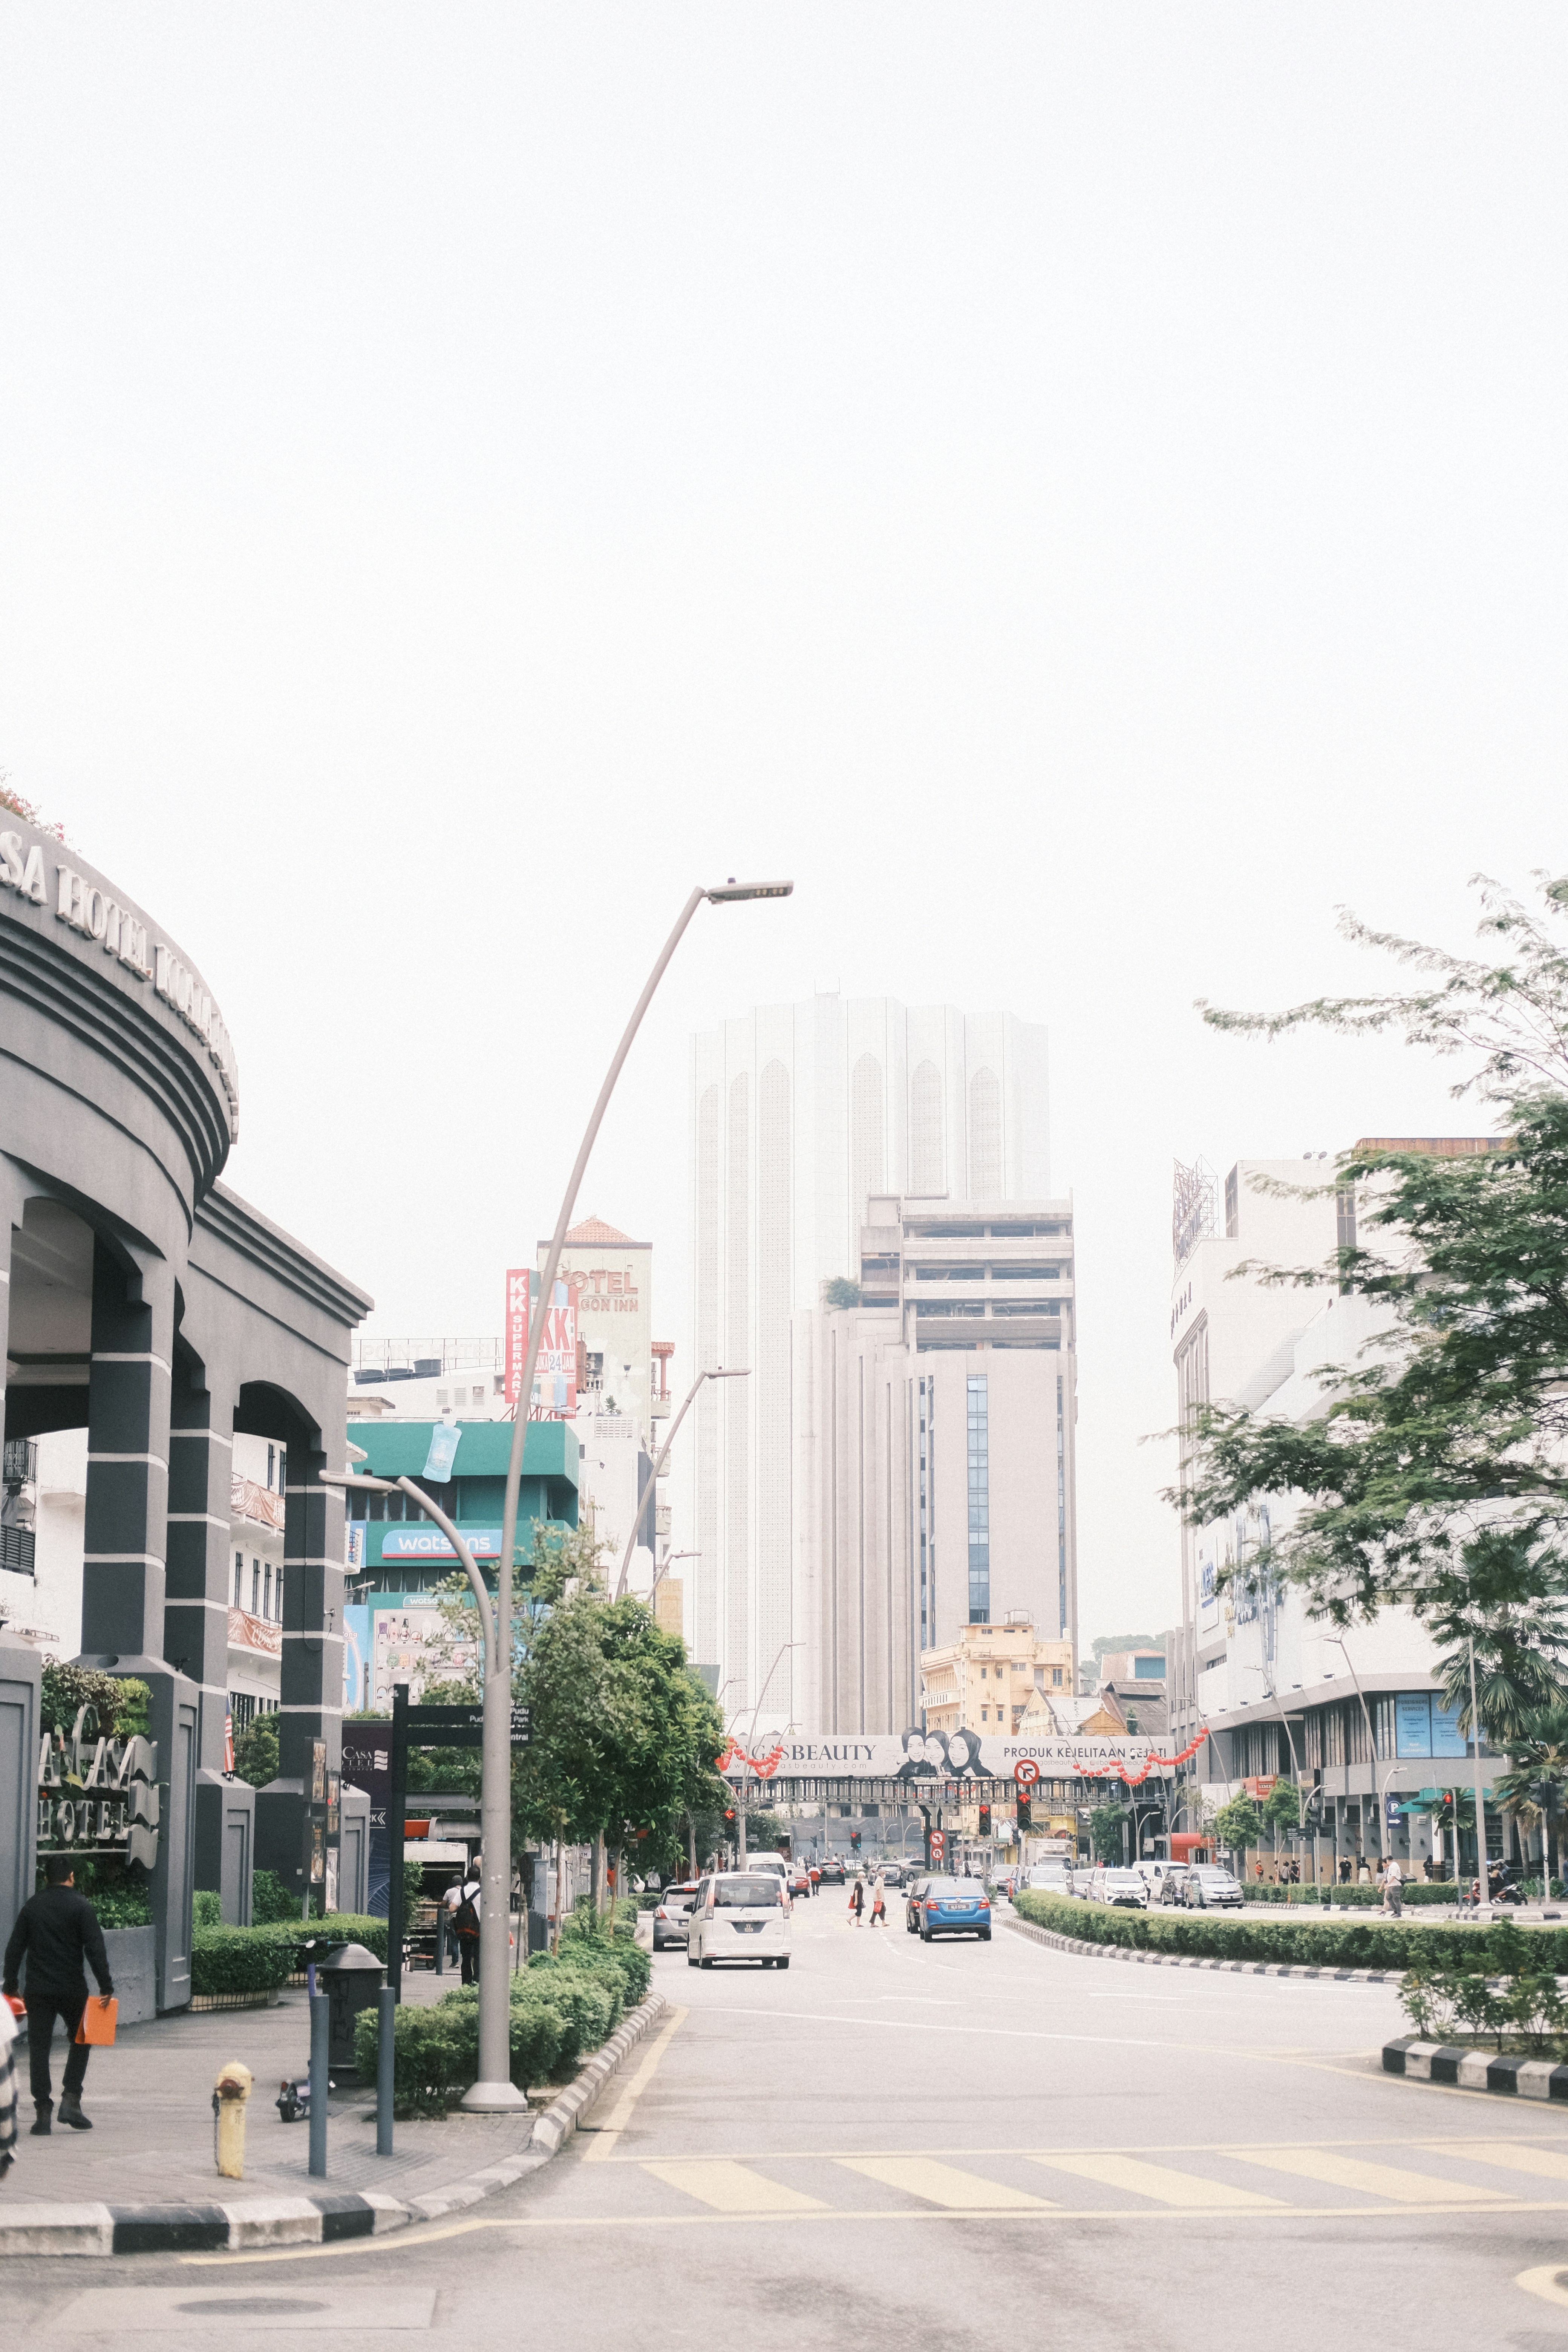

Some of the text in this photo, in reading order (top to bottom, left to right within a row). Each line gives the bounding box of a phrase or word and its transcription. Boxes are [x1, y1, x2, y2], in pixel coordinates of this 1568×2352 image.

[57, 865, 153, 982] HOTEL
[577, 1298, 638, 1312] GON INN
[510, 1277, 526, 1398] KK SUPERMART
[362, 1344, 424, 1360] POINT
[430, 1344, 497, 1359] HOTEL
[549, 1354, 561, 1371] 24
[562, 1355, 575, 1370] JAM
[398, 1536, 490, 1550] watsns
[1004, 1747, 1166, 1758] PRODUK KEJELITAAN EJTI
[1391, 1803, 1398, 1813] P
[37, 1799, 129, 1842] HOTEL
